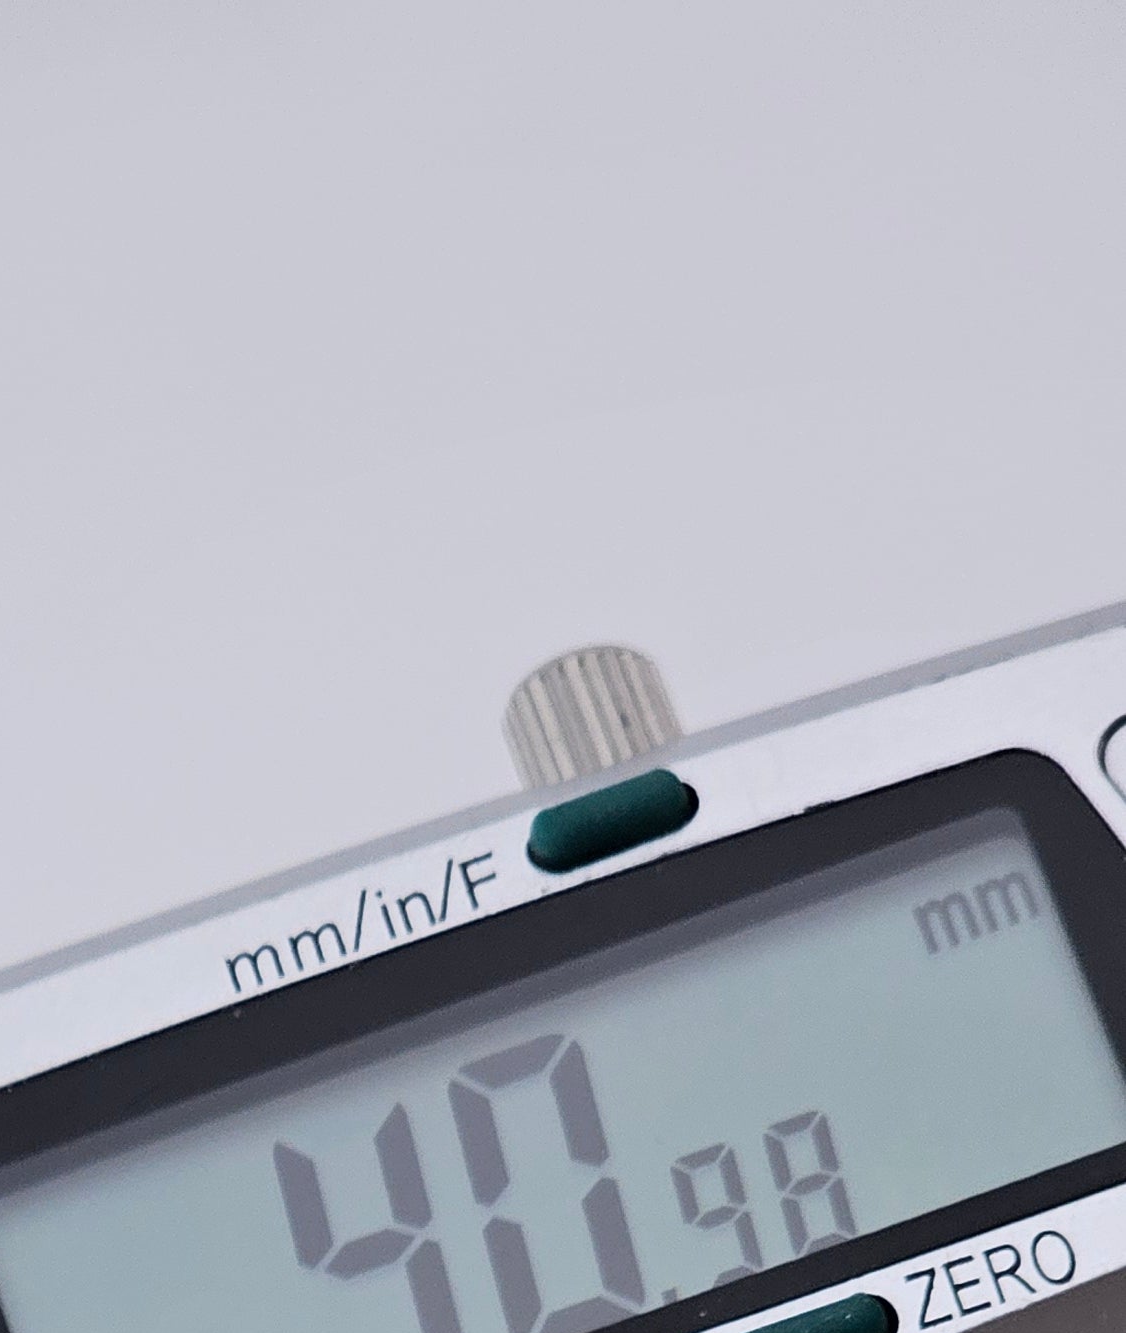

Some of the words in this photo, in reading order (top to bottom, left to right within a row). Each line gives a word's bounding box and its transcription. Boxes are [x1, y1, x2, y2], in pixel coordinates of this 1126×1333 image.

[224, 851, 498, 993] mm/in/F
[912, 870, 1040, 955] mm
[904, 1230, 1078, 1332] ZERO
